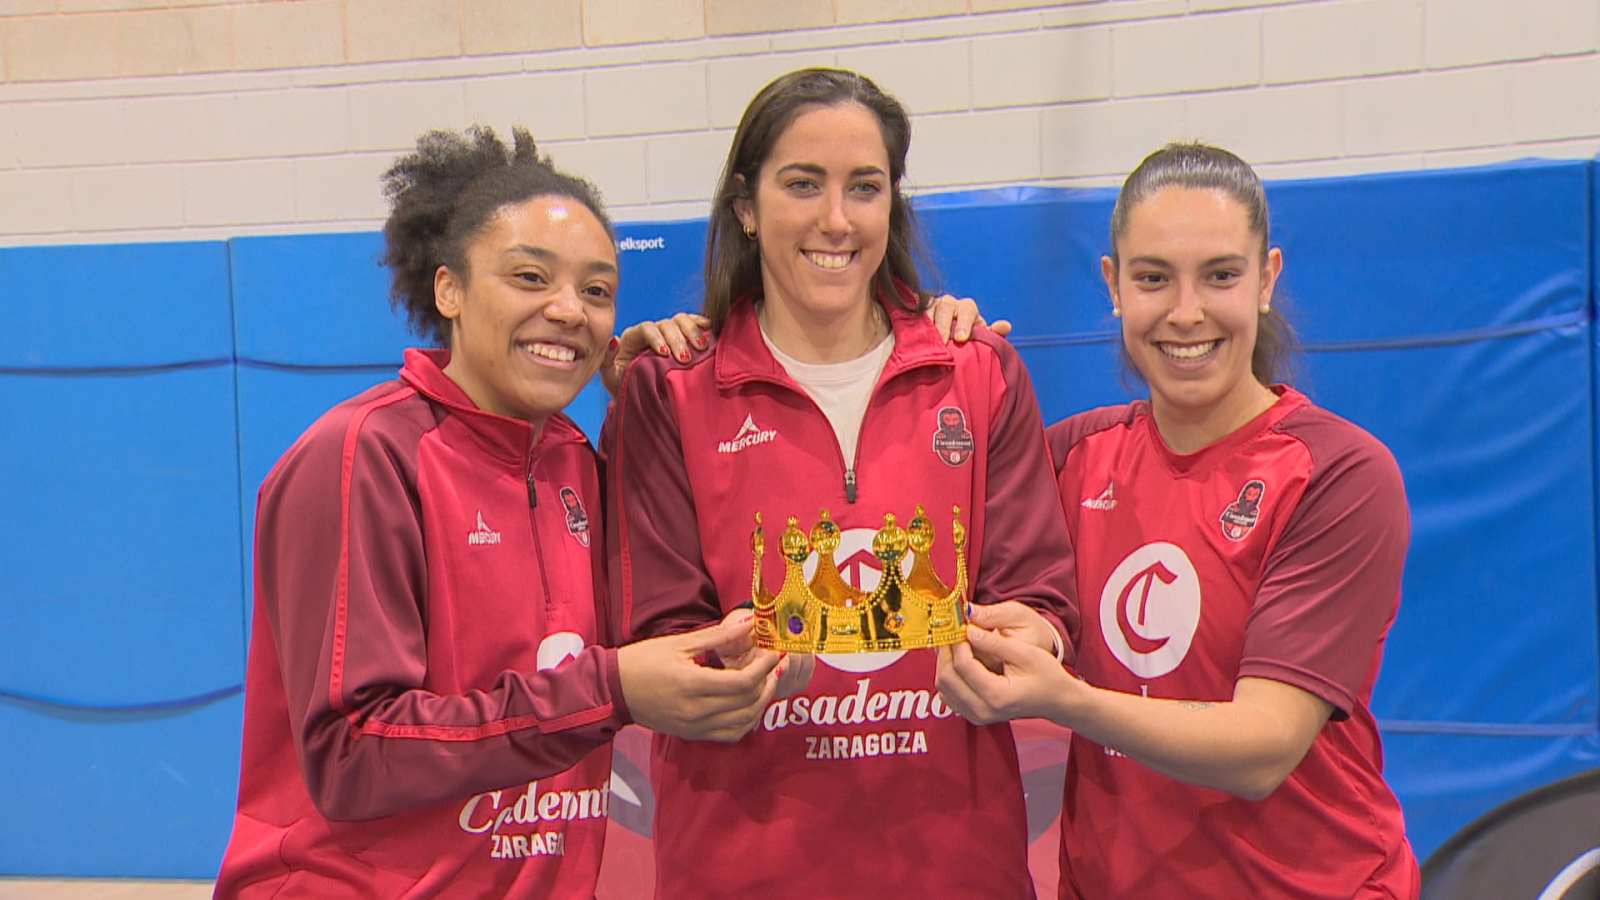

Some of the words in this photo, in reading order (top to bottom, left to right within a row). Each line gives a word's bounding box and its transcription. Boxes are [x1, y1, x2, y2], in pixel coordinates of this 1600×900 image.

[620, 236, 665, 252] elksport
[717, 429, 777, 453] MERCURY
[753, 678, 961, 732] asademo
[805, 731, 928, 760] ZARAGOZA
[490, 831, 565, 860] ZARAG
